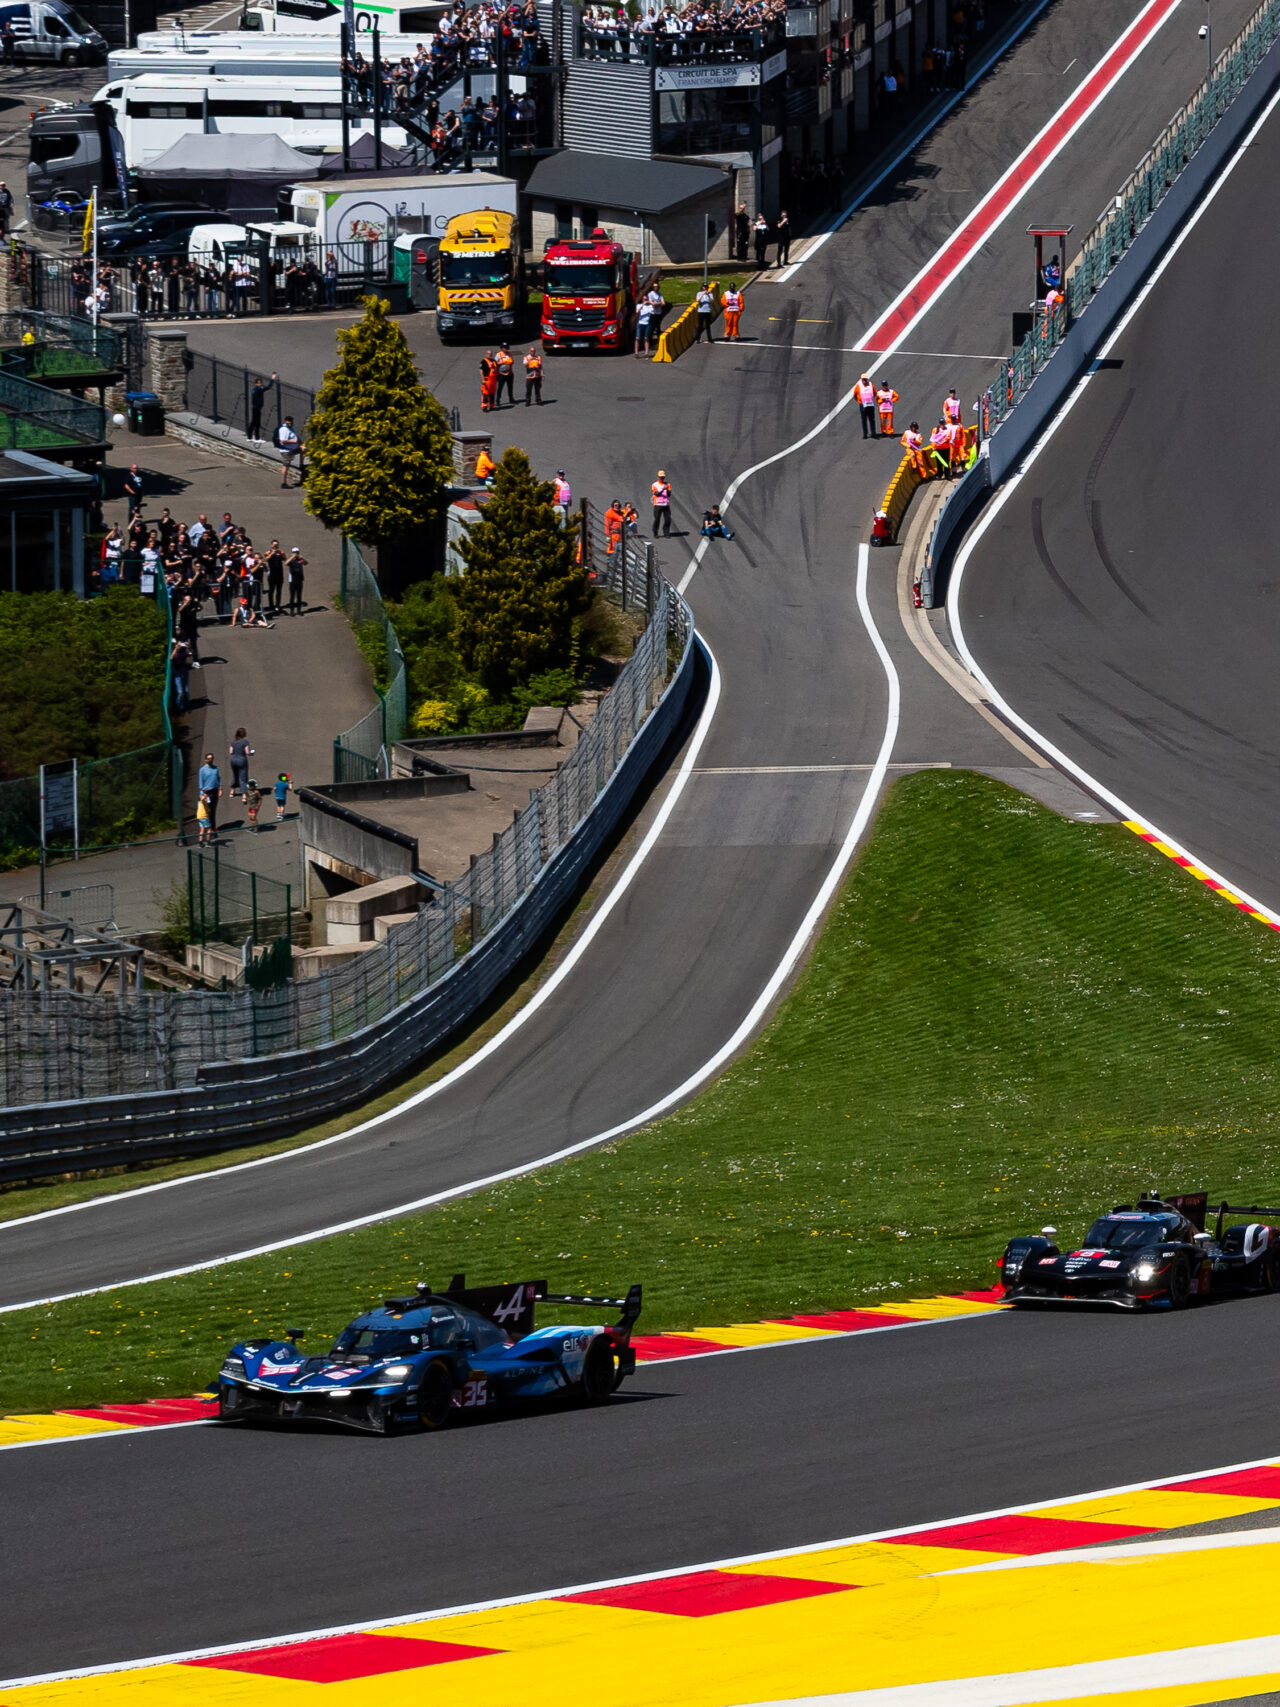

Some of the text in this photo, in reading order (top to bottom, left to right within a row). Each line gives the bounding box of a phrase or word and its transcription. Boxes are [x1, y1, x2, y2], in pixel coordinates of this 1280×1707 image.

[678, 67, 737, 78] CIRCUIT DE SPA
[563, 1338, 579, 1351] elf
[504, 1366, 545, 1378] ALPINE
[463, 1380, 488, 1407] 35
